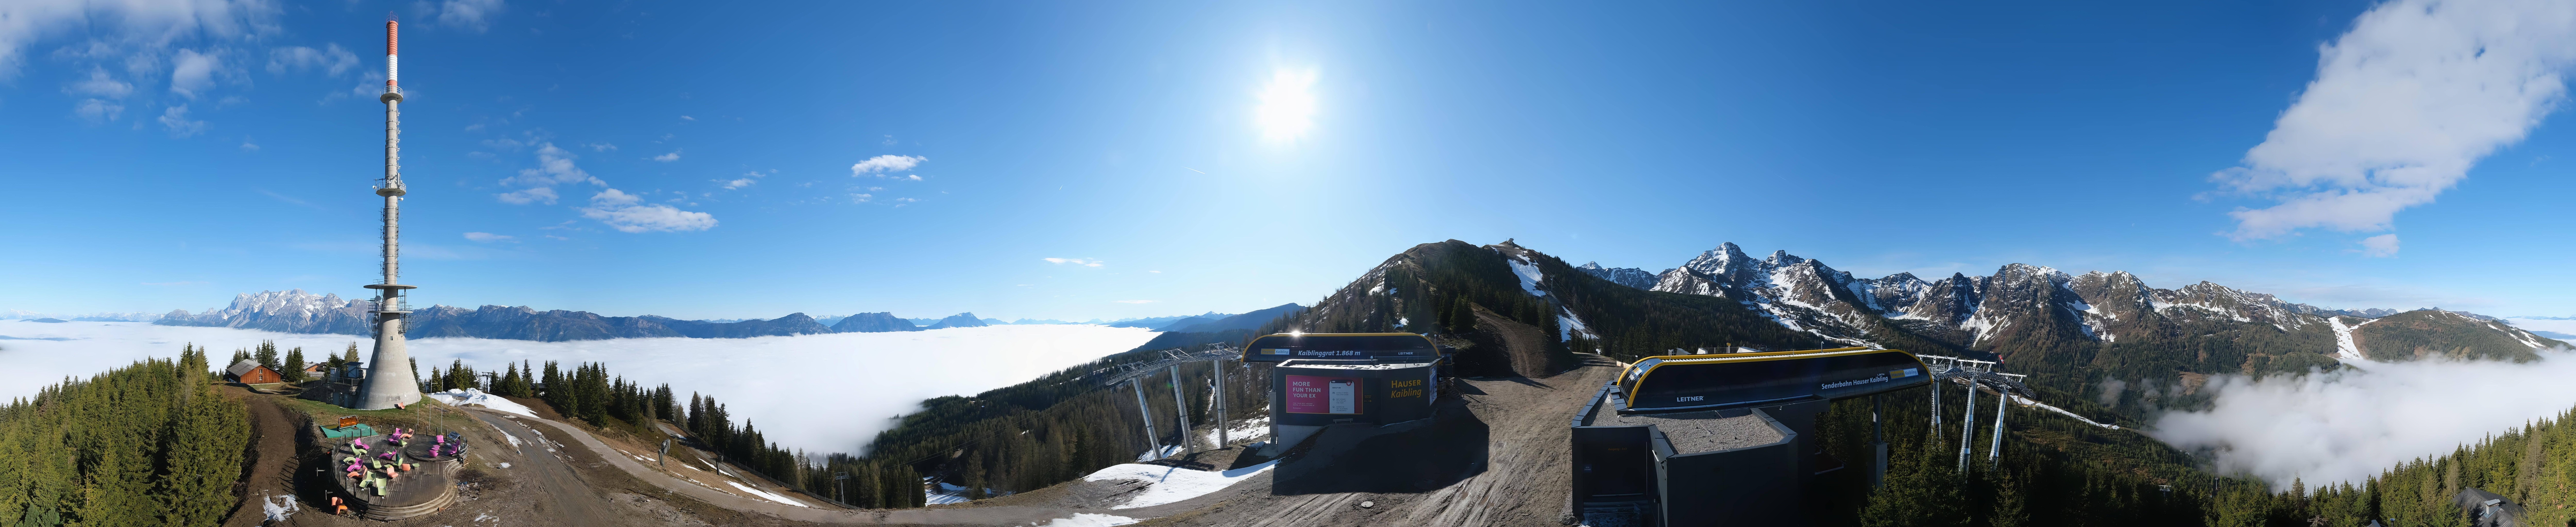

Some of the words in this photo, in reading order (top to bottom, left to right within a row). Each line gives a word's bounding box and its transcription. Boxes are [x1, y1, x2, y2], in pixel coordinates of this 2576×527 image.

[1391, 380, 1421, 388] HAUSER
[1822, 380, 1852, 389] Senderbahn
[1391, 388, 1422, 398] Kaibling
